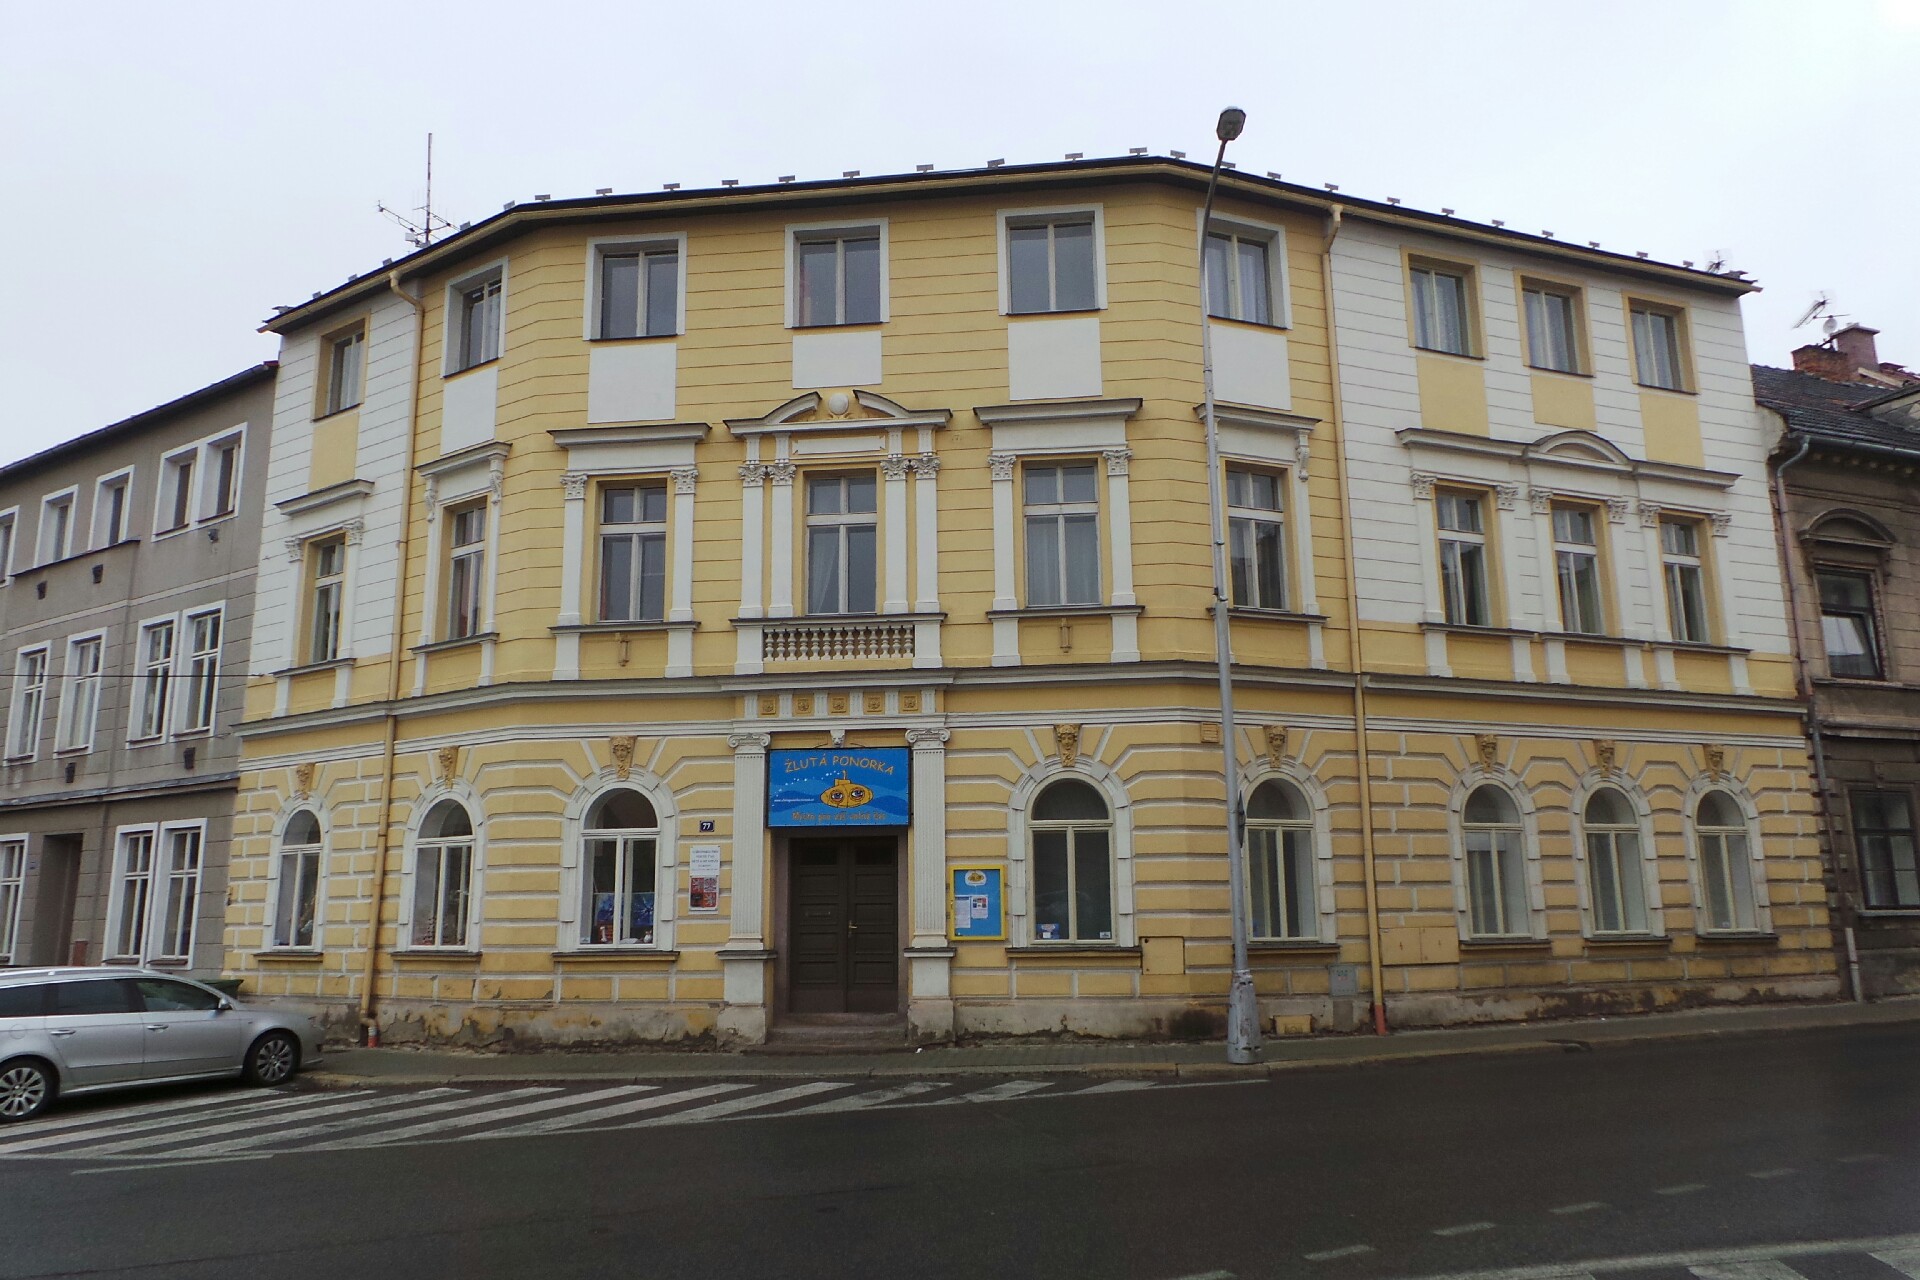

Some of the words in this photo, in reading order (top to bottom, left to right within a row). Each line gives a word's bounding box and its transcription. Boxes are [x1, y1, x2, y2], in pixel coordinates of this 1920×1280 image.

[784, 754, 827, 773] ŽLUTÁ
[832, 755, 895, 774] PONORKA
[702, 822, 711, 830] 77
